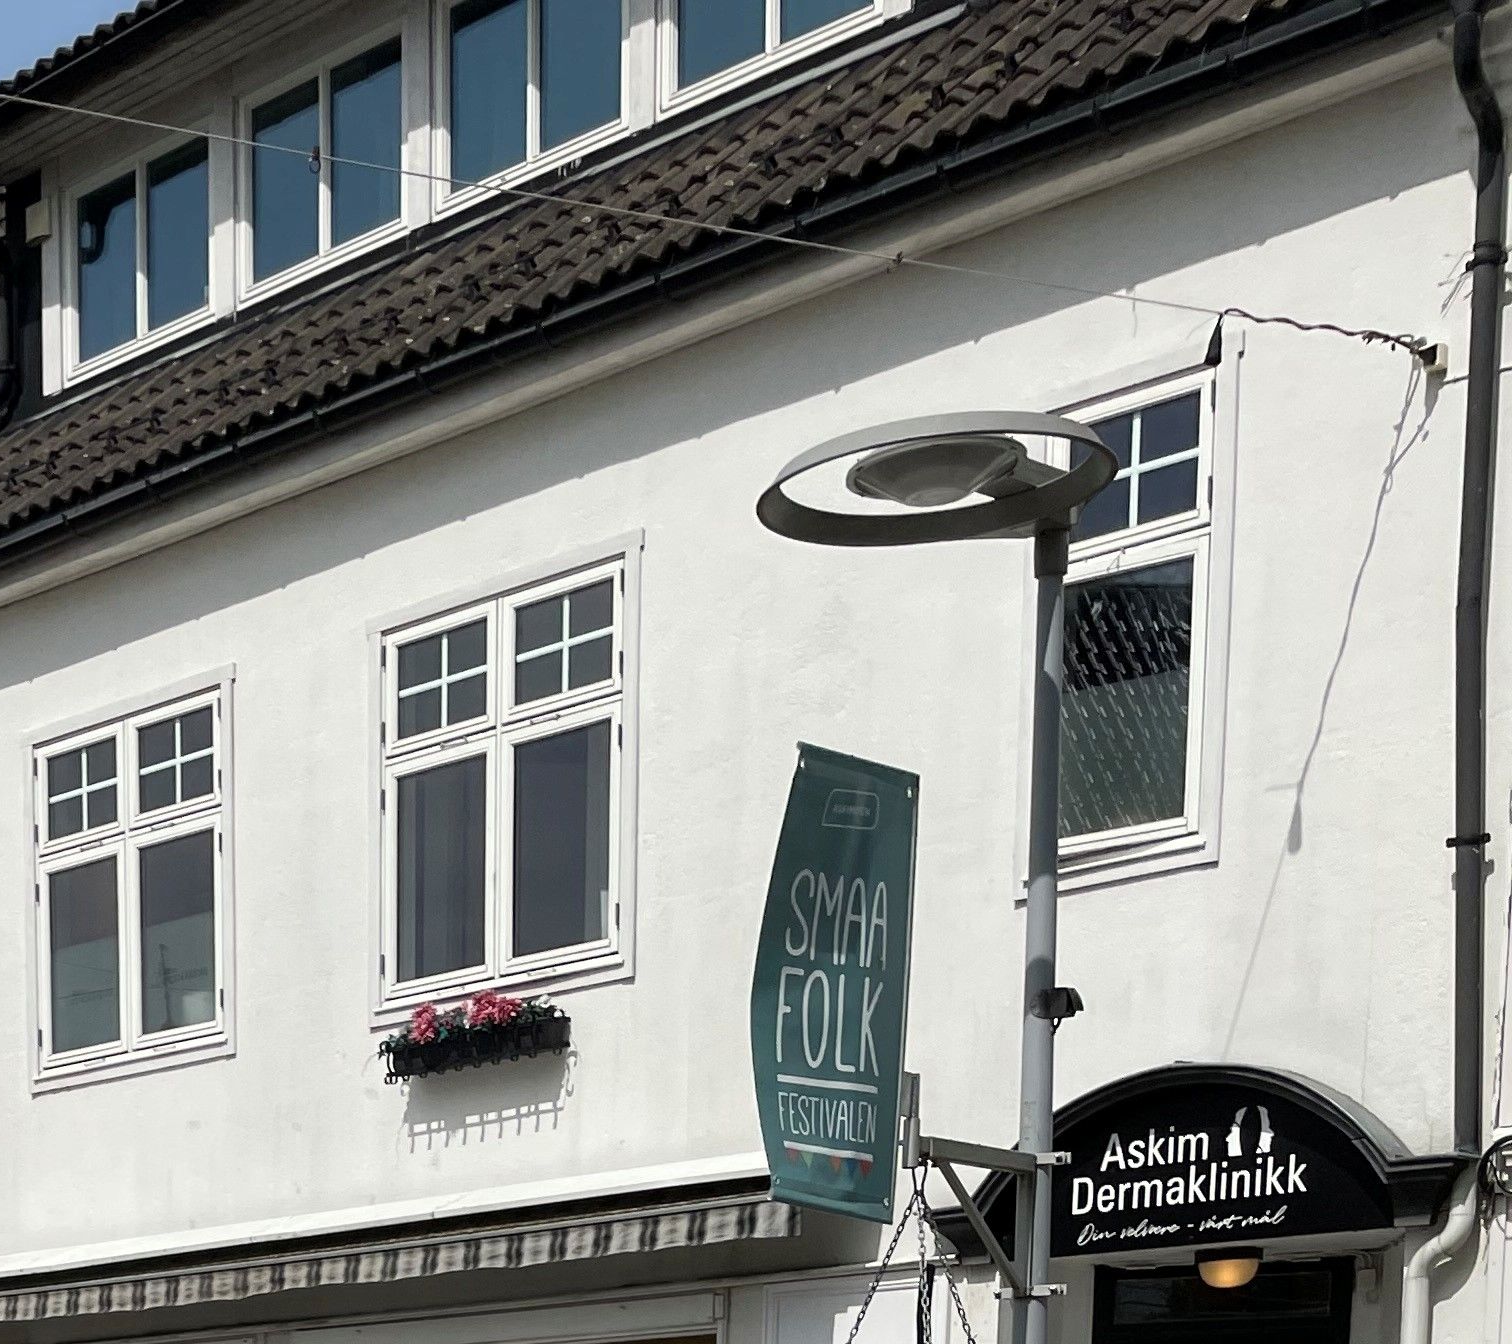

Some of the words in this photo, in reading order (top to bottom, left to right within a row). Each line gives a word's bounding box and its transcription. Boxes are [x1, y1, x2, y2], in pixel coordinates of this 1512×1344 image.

[785, 868, 888, 970] SMAA
[775, 966, 884, 1076] FOLK
[778, 1091, 878, 1144] FESTIVALEN
[1100, 1126, 1209, 1171] Askim
[1072, 1154, 1307, 1216] Dermaklinikk
[1077, 1223, 1116, 1247] Din
[1242, 1205, 1288, 1227] mål
